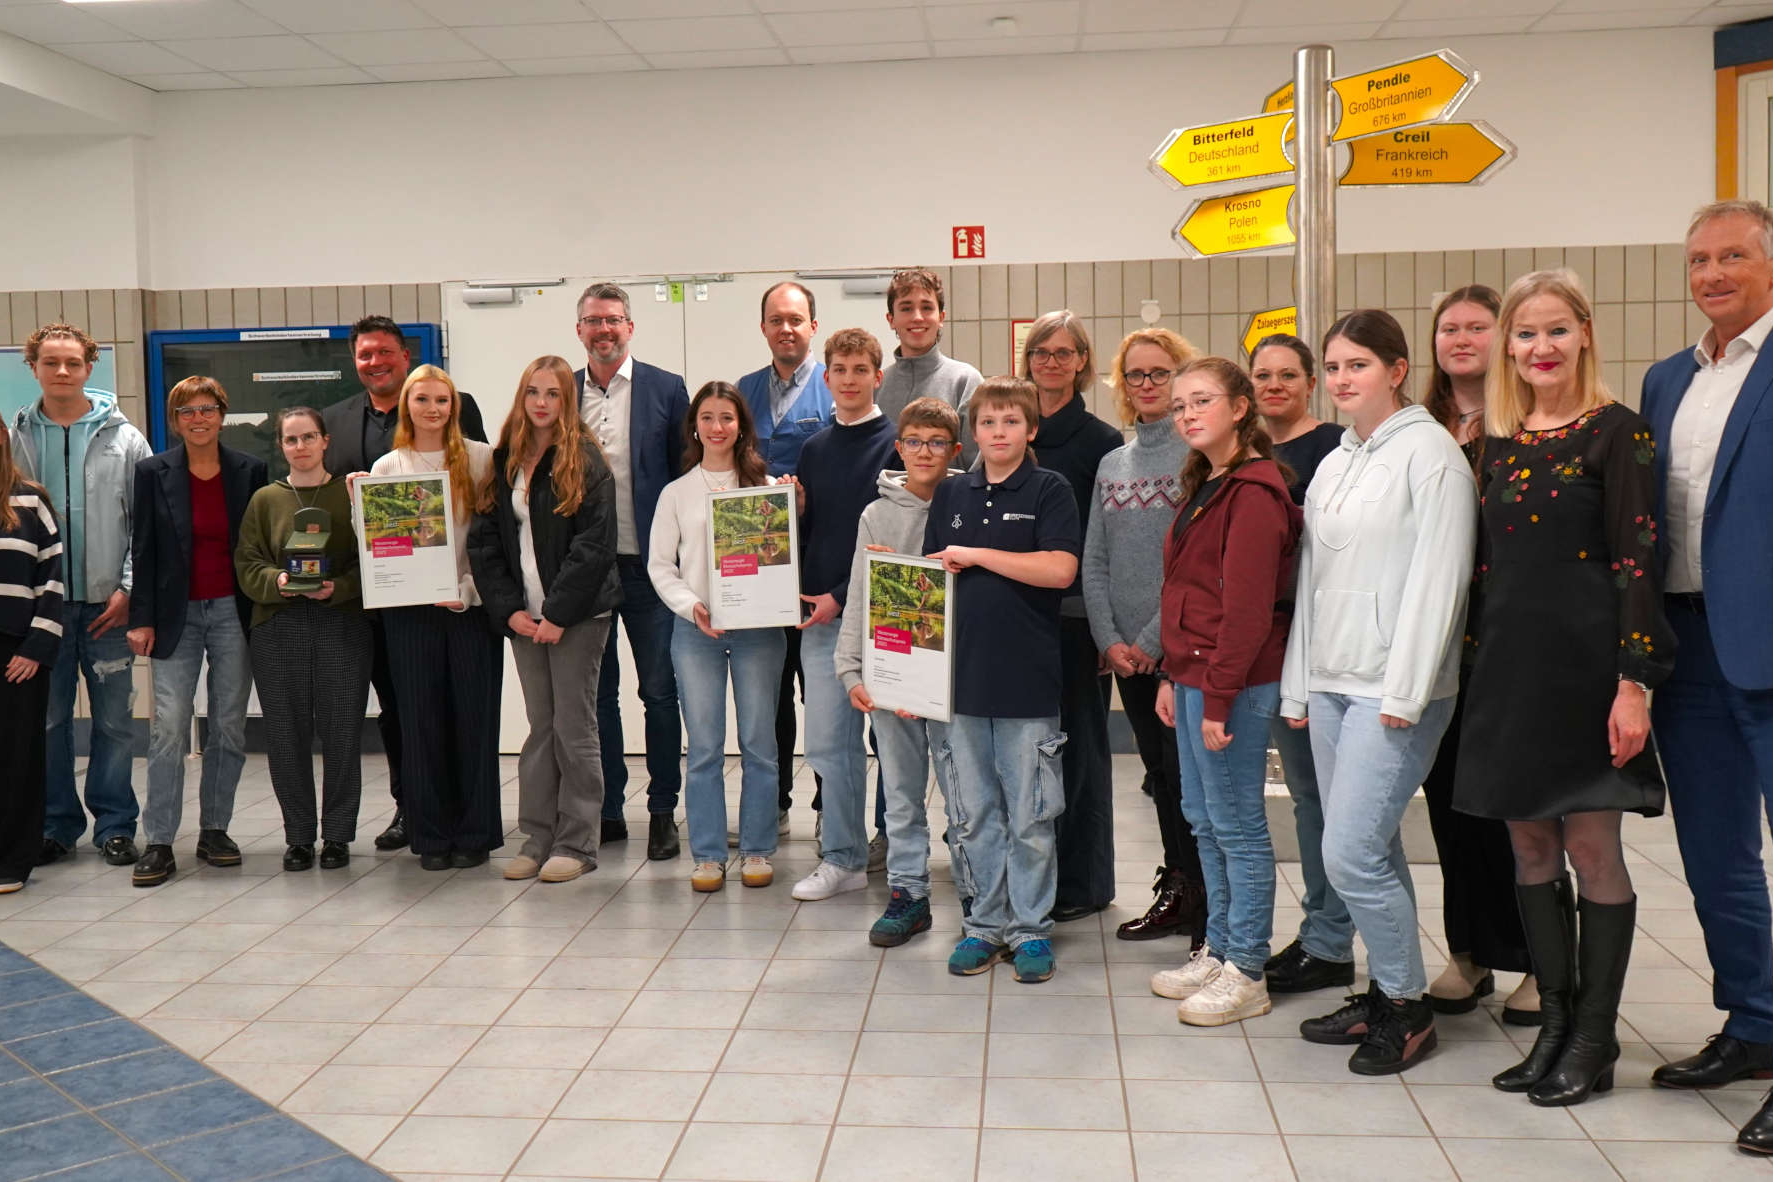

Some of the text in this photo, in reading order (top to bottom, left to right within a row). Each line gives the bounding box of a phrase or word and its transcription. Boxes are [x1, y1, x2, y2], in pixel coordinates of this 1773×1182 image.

[1367, 72, 1411, 92] Pendle
[1348, 86, 1432, 115] Großbritannien
[1373, 112, 1407, 127] 676 km
[1193, 125, 1255, 146] Bitterfeld
[1393, 131, 1430, 143] Creil
[1188, 142, 1259, 164] Deutschland
[1376, 148, 1448, 161] Frankreich
[1207, 164, 1241, 177] 361 km
[1391, 168, 1433, 177] 419 km
[1224, 199, 1261, 213] Krosno
[1229, 216, 1258, 229] Polen
[1248, 232, 1261, 242] km
[1256, 315, 1296, 330] Zalaegersze
